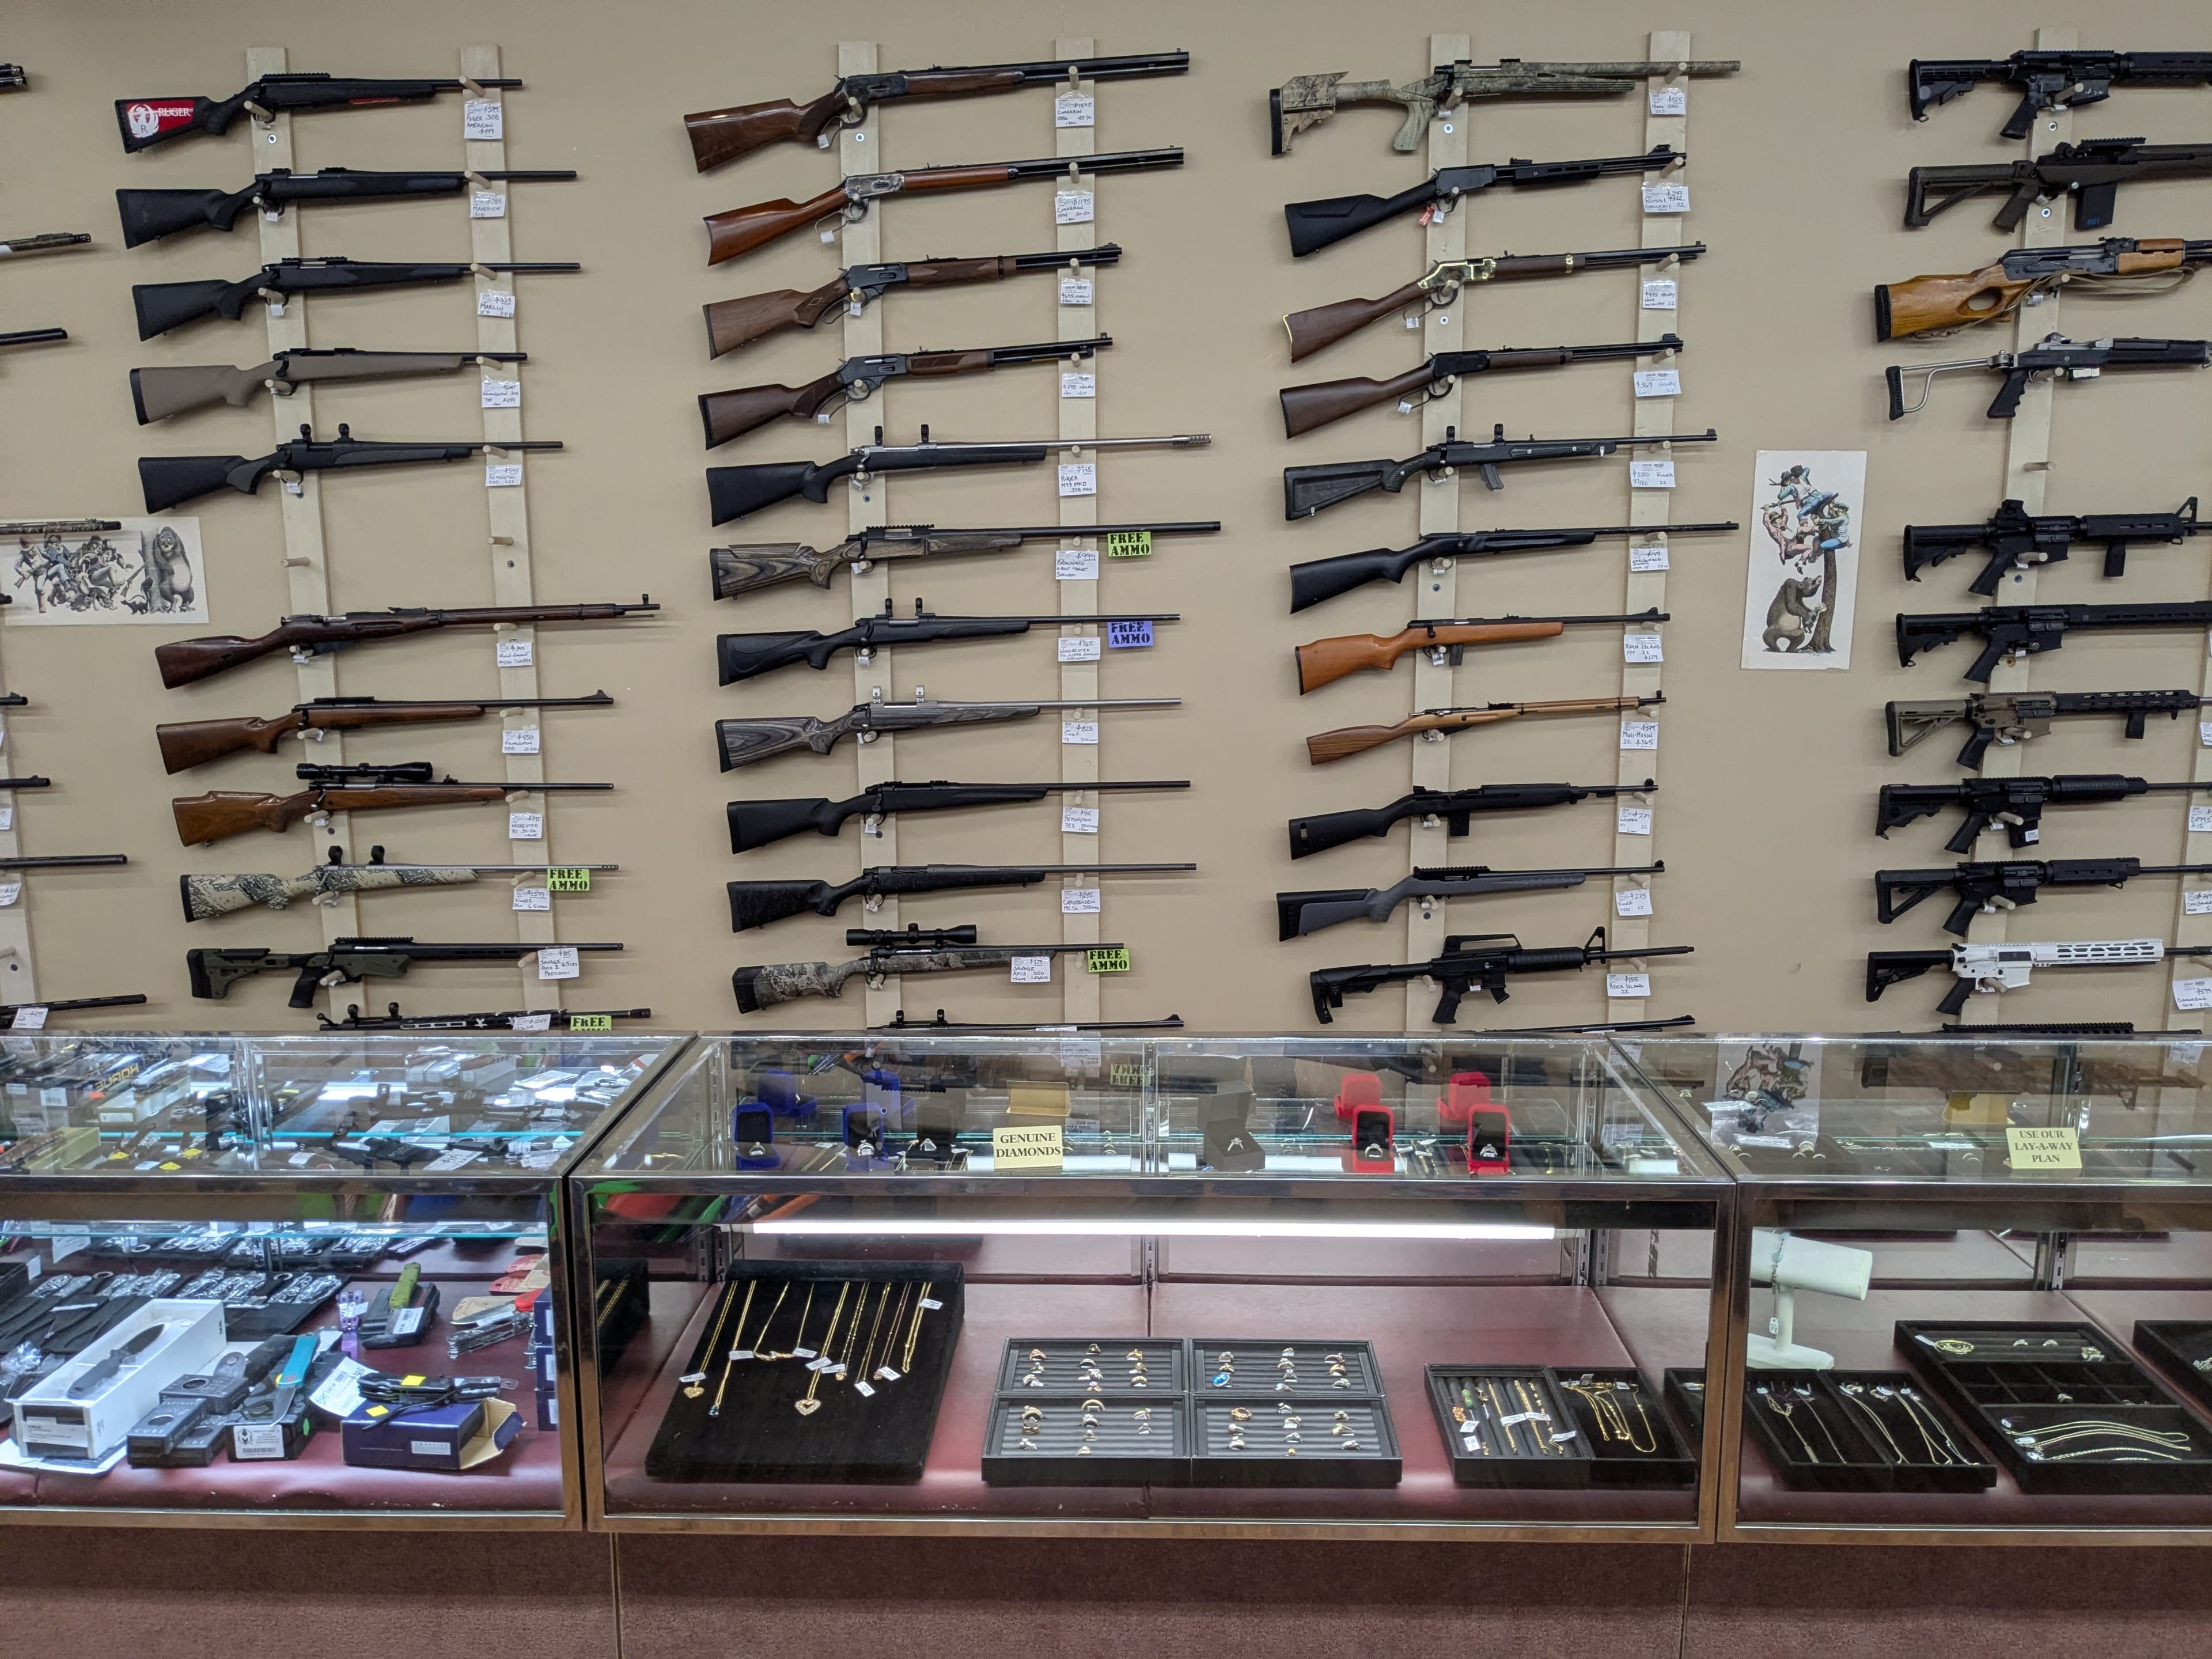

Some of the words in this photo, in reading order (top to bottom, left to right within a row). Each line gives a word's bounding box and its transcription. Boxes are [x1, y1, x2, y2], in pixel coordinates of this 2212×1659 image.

[157, 108, 191, 116] RUGER
[141, 124, 147, 133] R
[480, 302, 503, 310] MARLIN
[1631, 469, 1650, 478] $550
[1109, 533, 1143, 544] FREE
[1111, 544, 1150, 556] AMMO
[1111, 622, 1145, 633] FREE
[1112, 633, 1150, 645] AMMO
[550, 869, 582, 879] FREE
[549, 880, 588, 890] AMMO
[1089, 950, 1122, 960] FREE
[1090, 960, 1127, 971] AMMO
[1624, 975, 1638, 983] $155
[573, 1017, 605, 1027] FREE
[1000, 1132, 1056, 1143] GENUINE
[2019, 1130, 2039, 1138] USE
[2041, 1130, 2065, 1138] OUR
[2014, 1142, 2073, 1150] LAY-A-WAY
[995, 1146, 1060, 1158] DIAMONDS
[2031, 1154, 2061, 1162] PLAN
